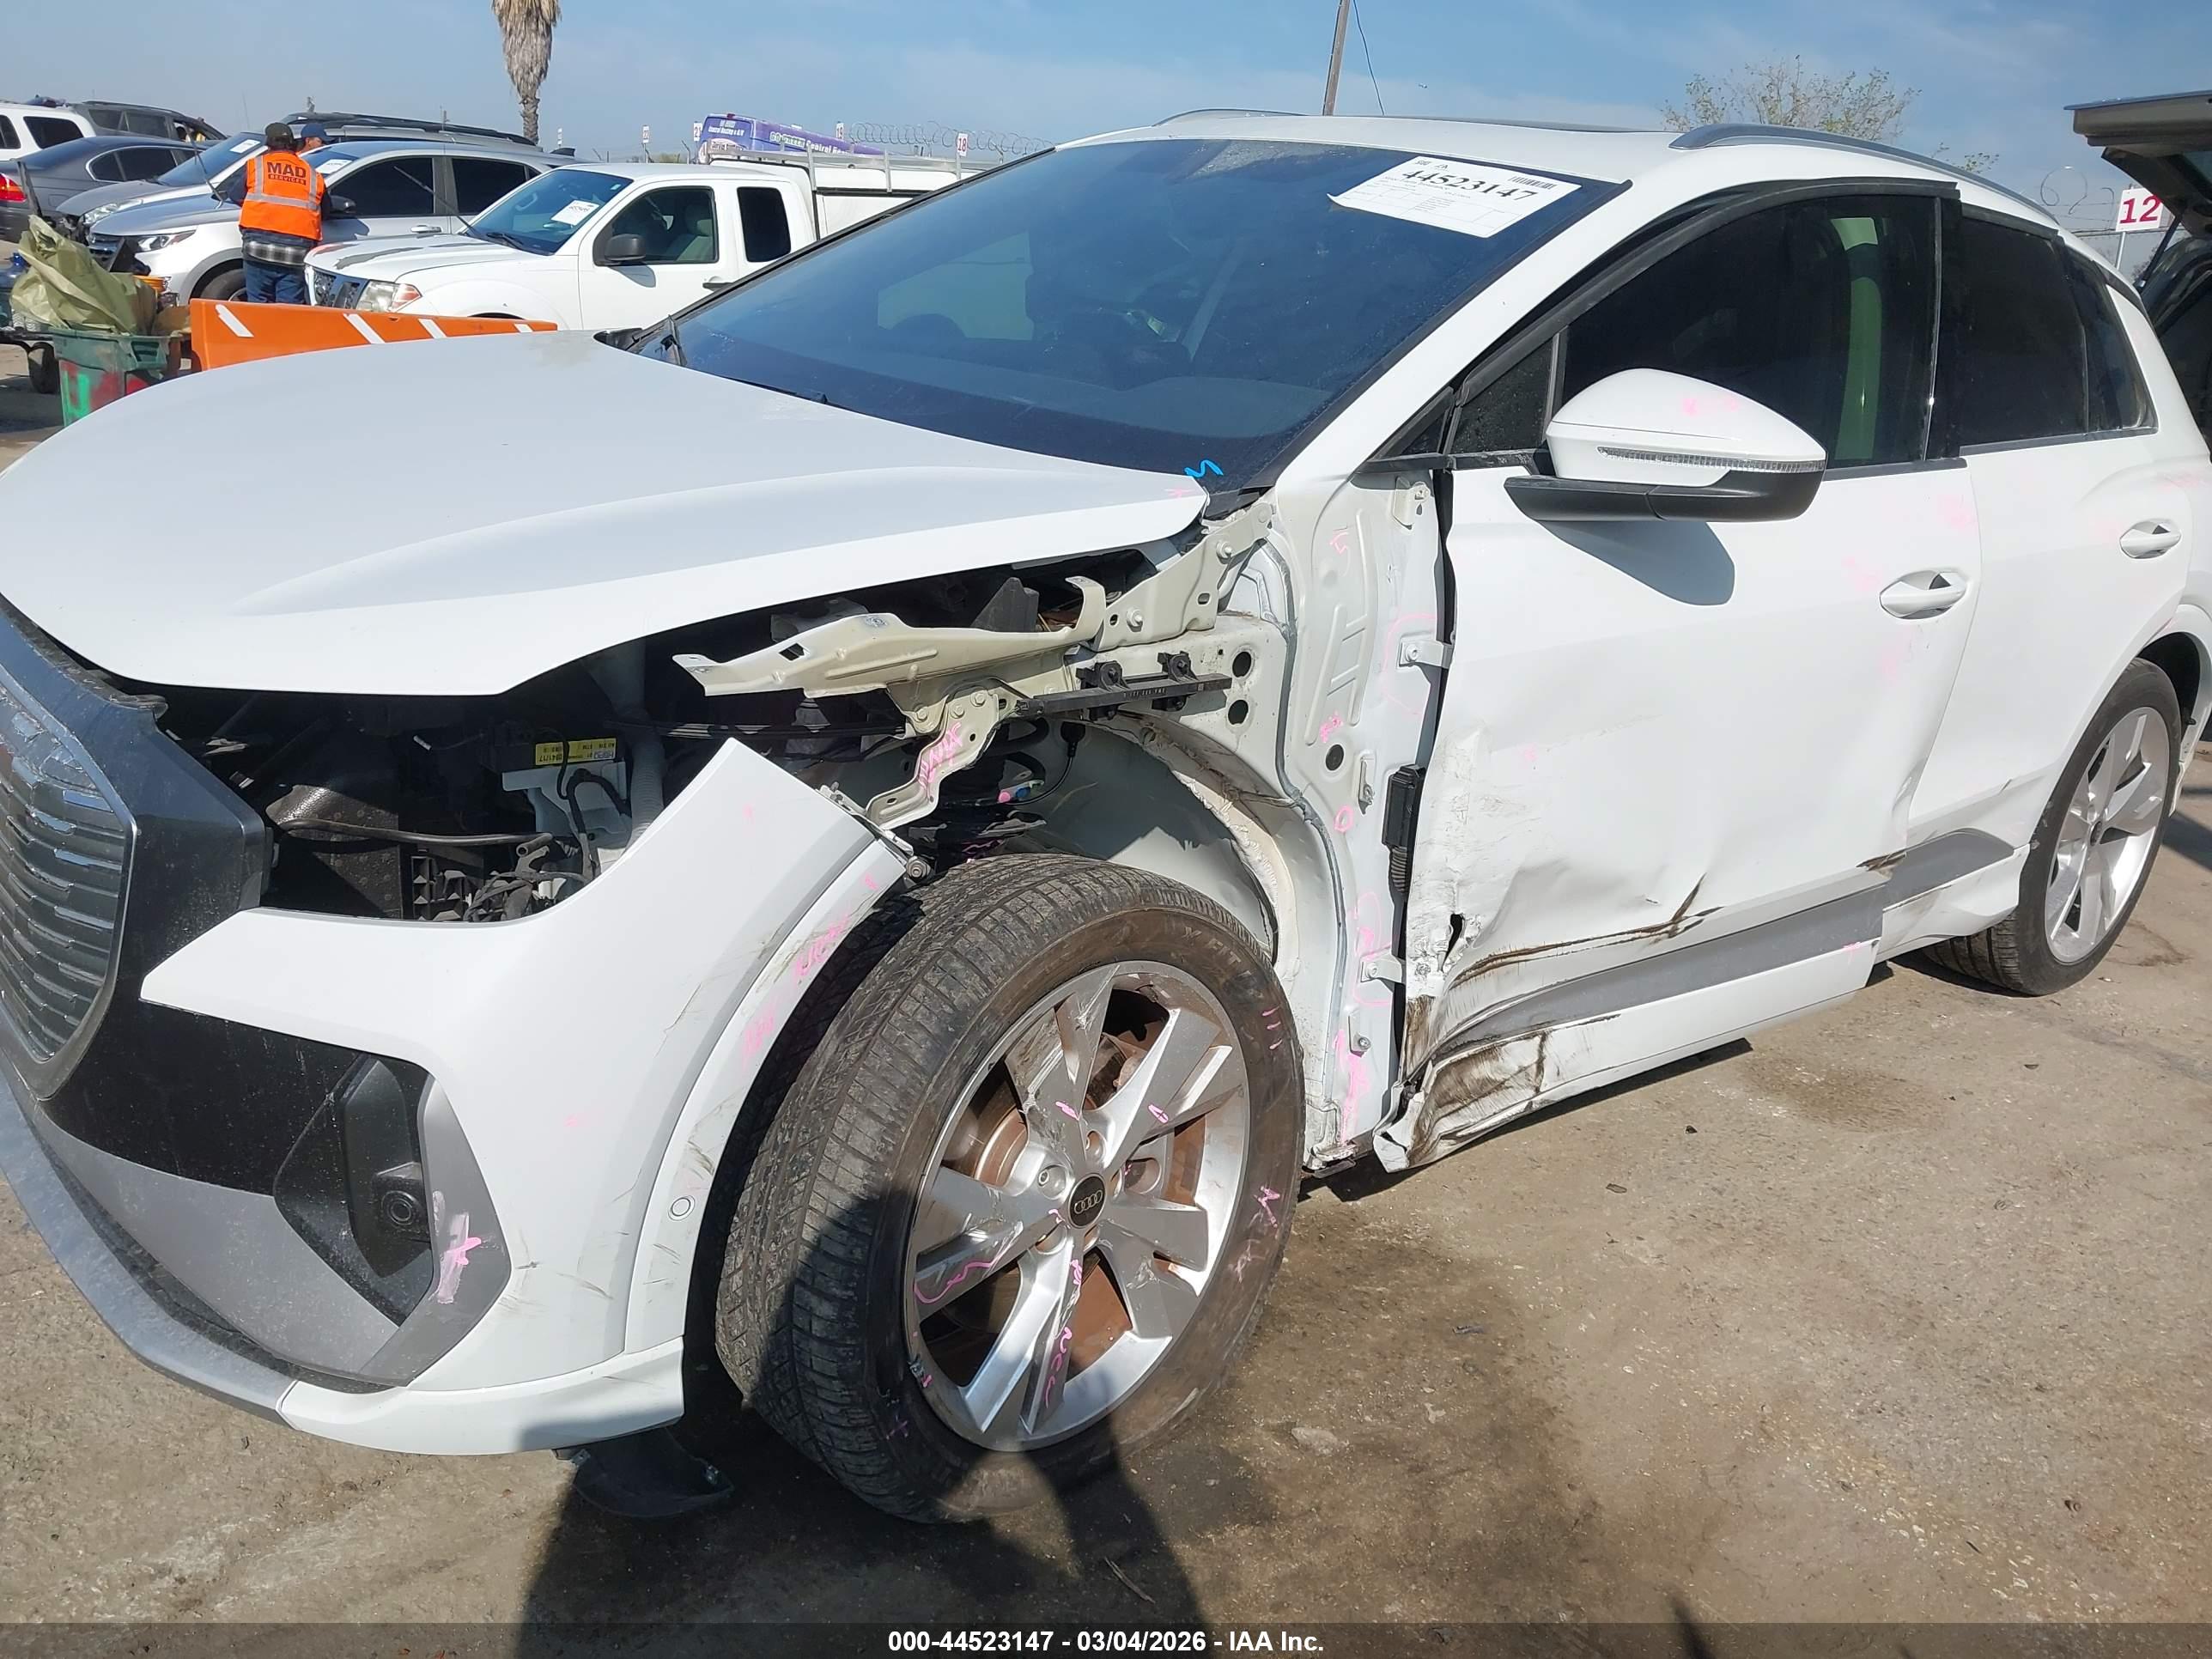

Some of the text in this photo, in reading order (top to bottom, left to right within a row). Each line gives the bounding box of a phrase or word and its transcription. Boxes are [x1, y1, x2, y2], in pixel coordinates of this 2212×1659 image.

[836, 125, 843, 139] 19
[958, 138, 967, 152] 18
[267, 161, 307, 179] MAD
[268, 173, 307, 185] SERVICES
[1401, 170, 1538, 201] 44523147
[2119, 195, 2161, 224] 12
